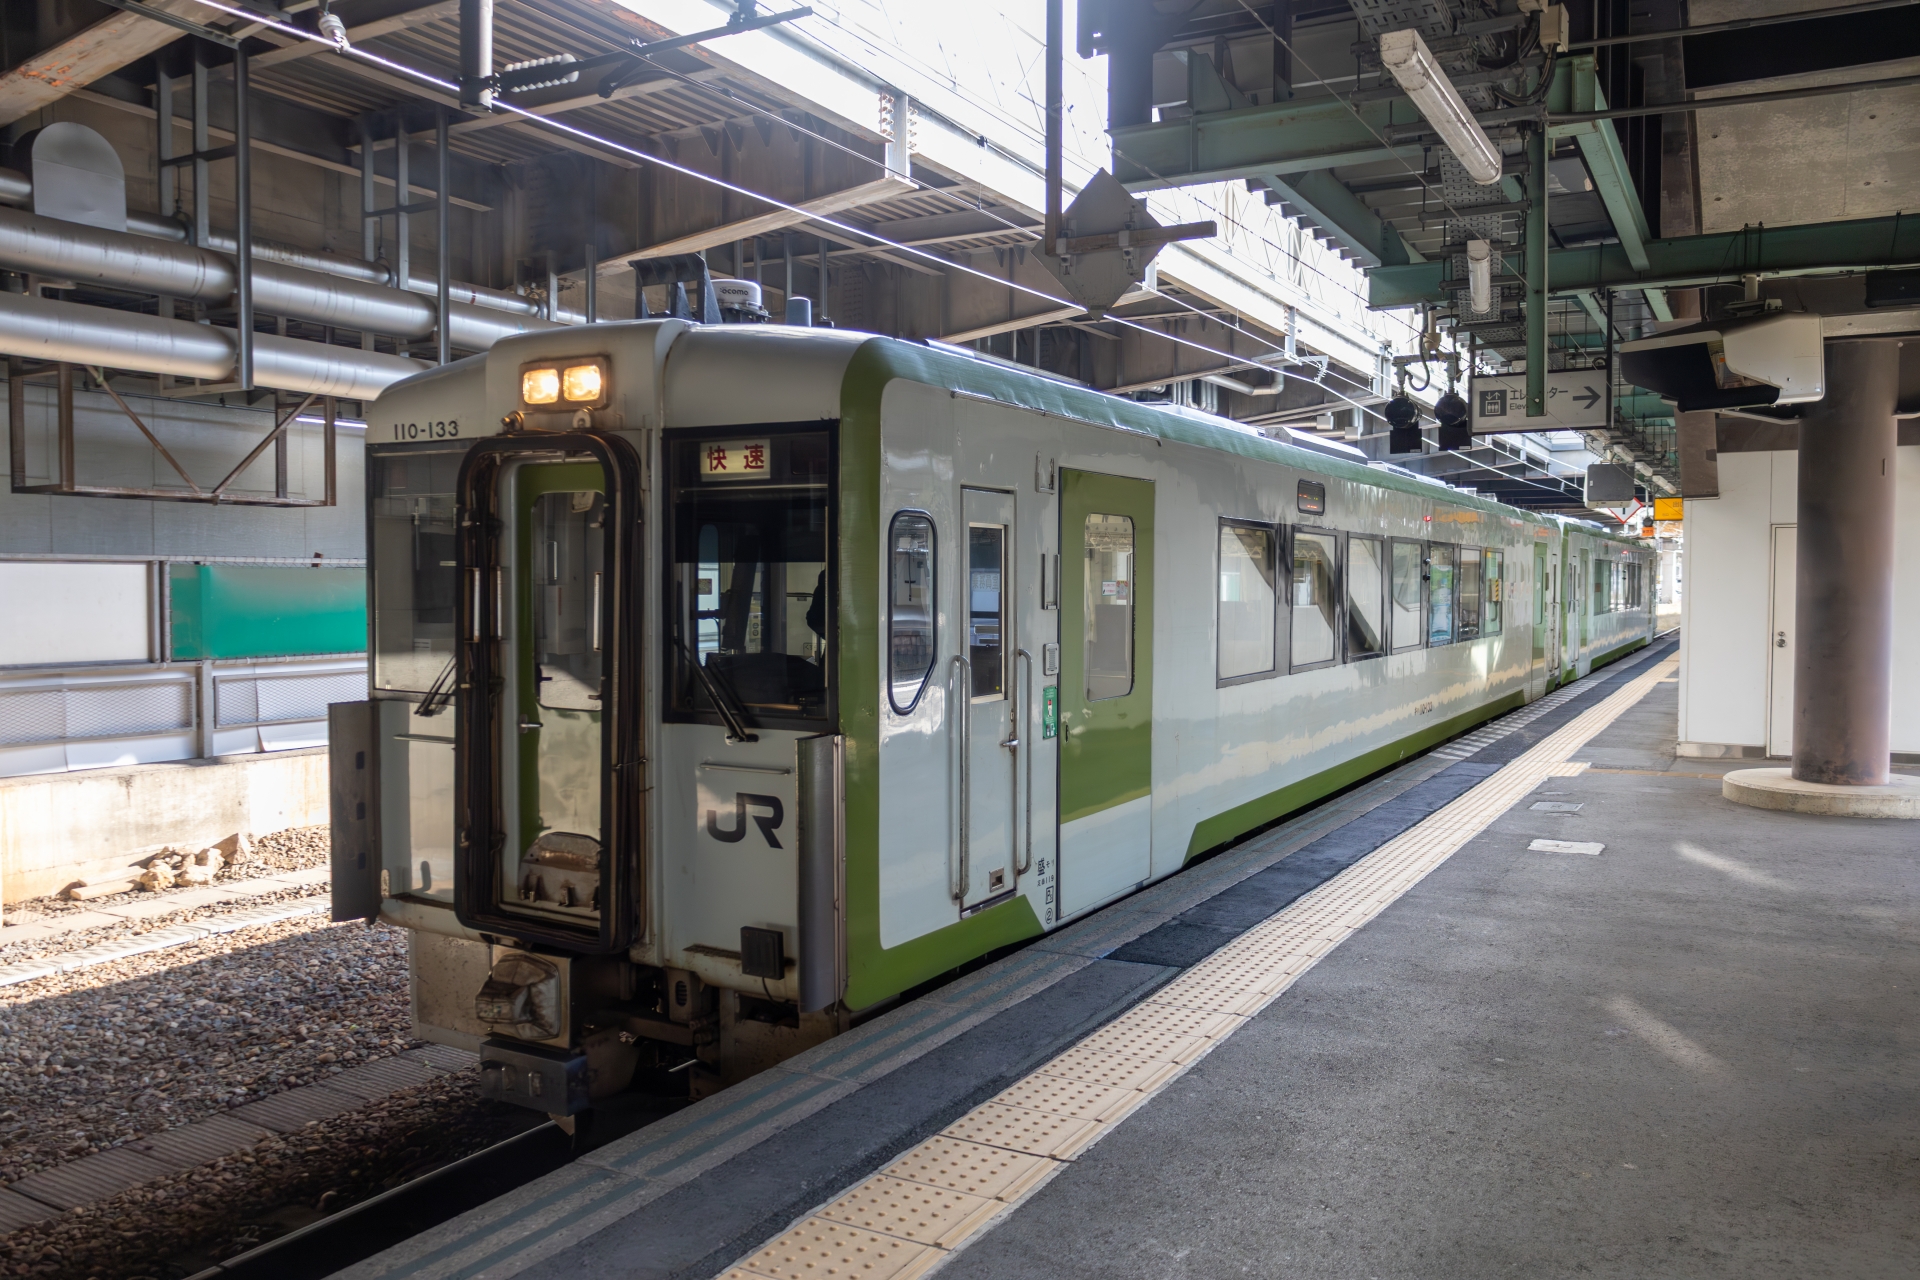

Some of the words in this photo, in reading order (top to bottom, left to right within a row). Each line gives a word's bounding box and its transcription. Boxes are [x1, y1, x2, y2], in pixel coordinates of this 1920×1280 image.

[1509, 386, 1569, 401] エレター
[394, 420, 459, 441] 110-133
[706, 443, 765, 472] 快速
[706, 791, 784, 850] JR
